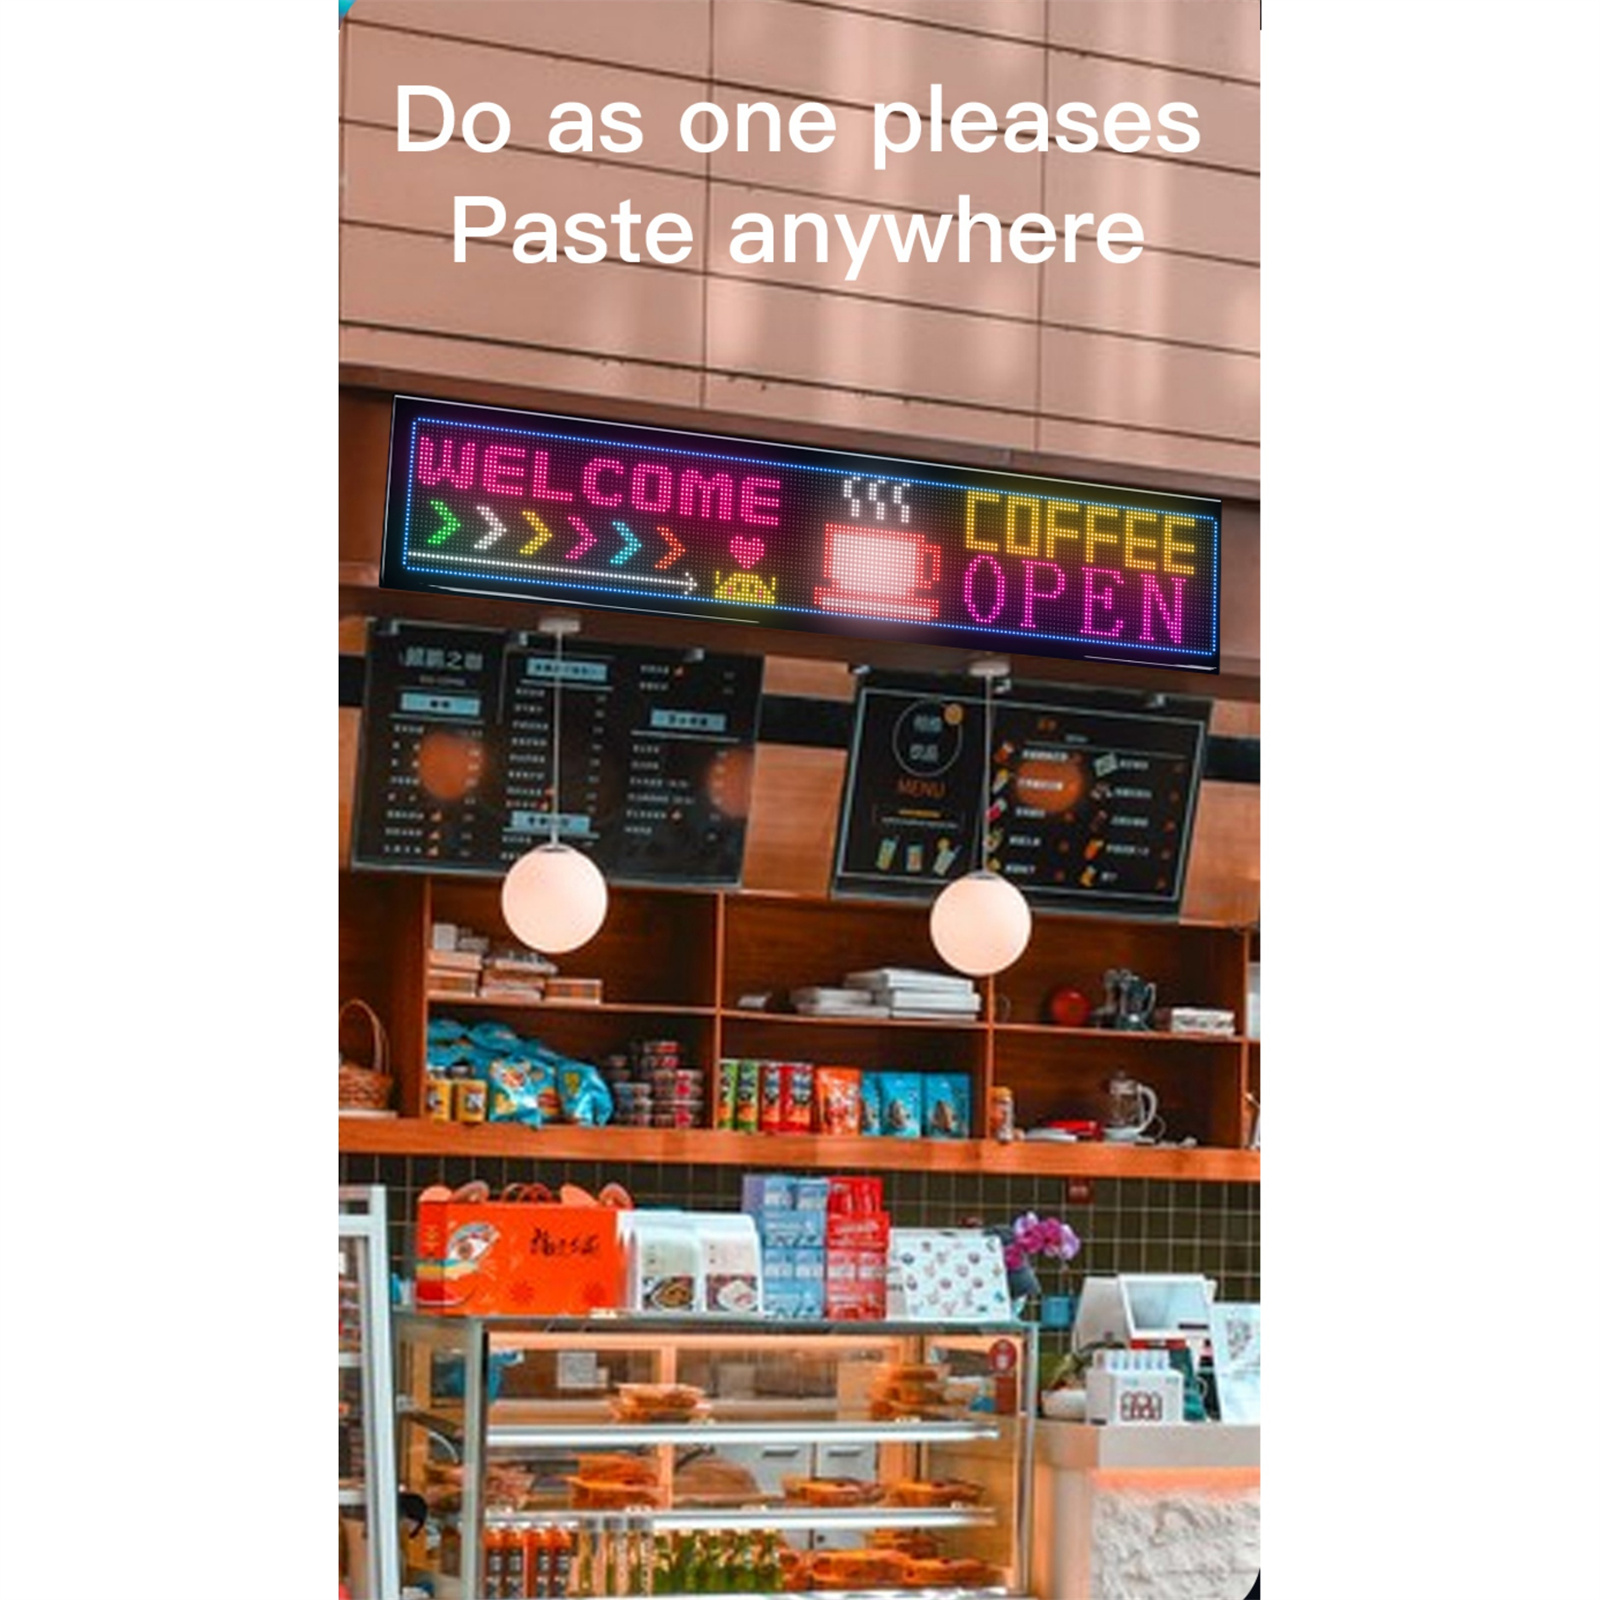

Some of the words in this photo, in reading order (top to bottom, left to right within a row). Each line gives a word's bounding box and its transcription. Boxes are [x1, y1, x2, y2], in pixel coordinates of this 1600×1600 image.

[417, 436, 781, 526] WELCOME
[965, 490, 1196, 575] COFFEE
[964, 554, 1187, 644] OPEN
[897, 776, 946, 800] MENU
